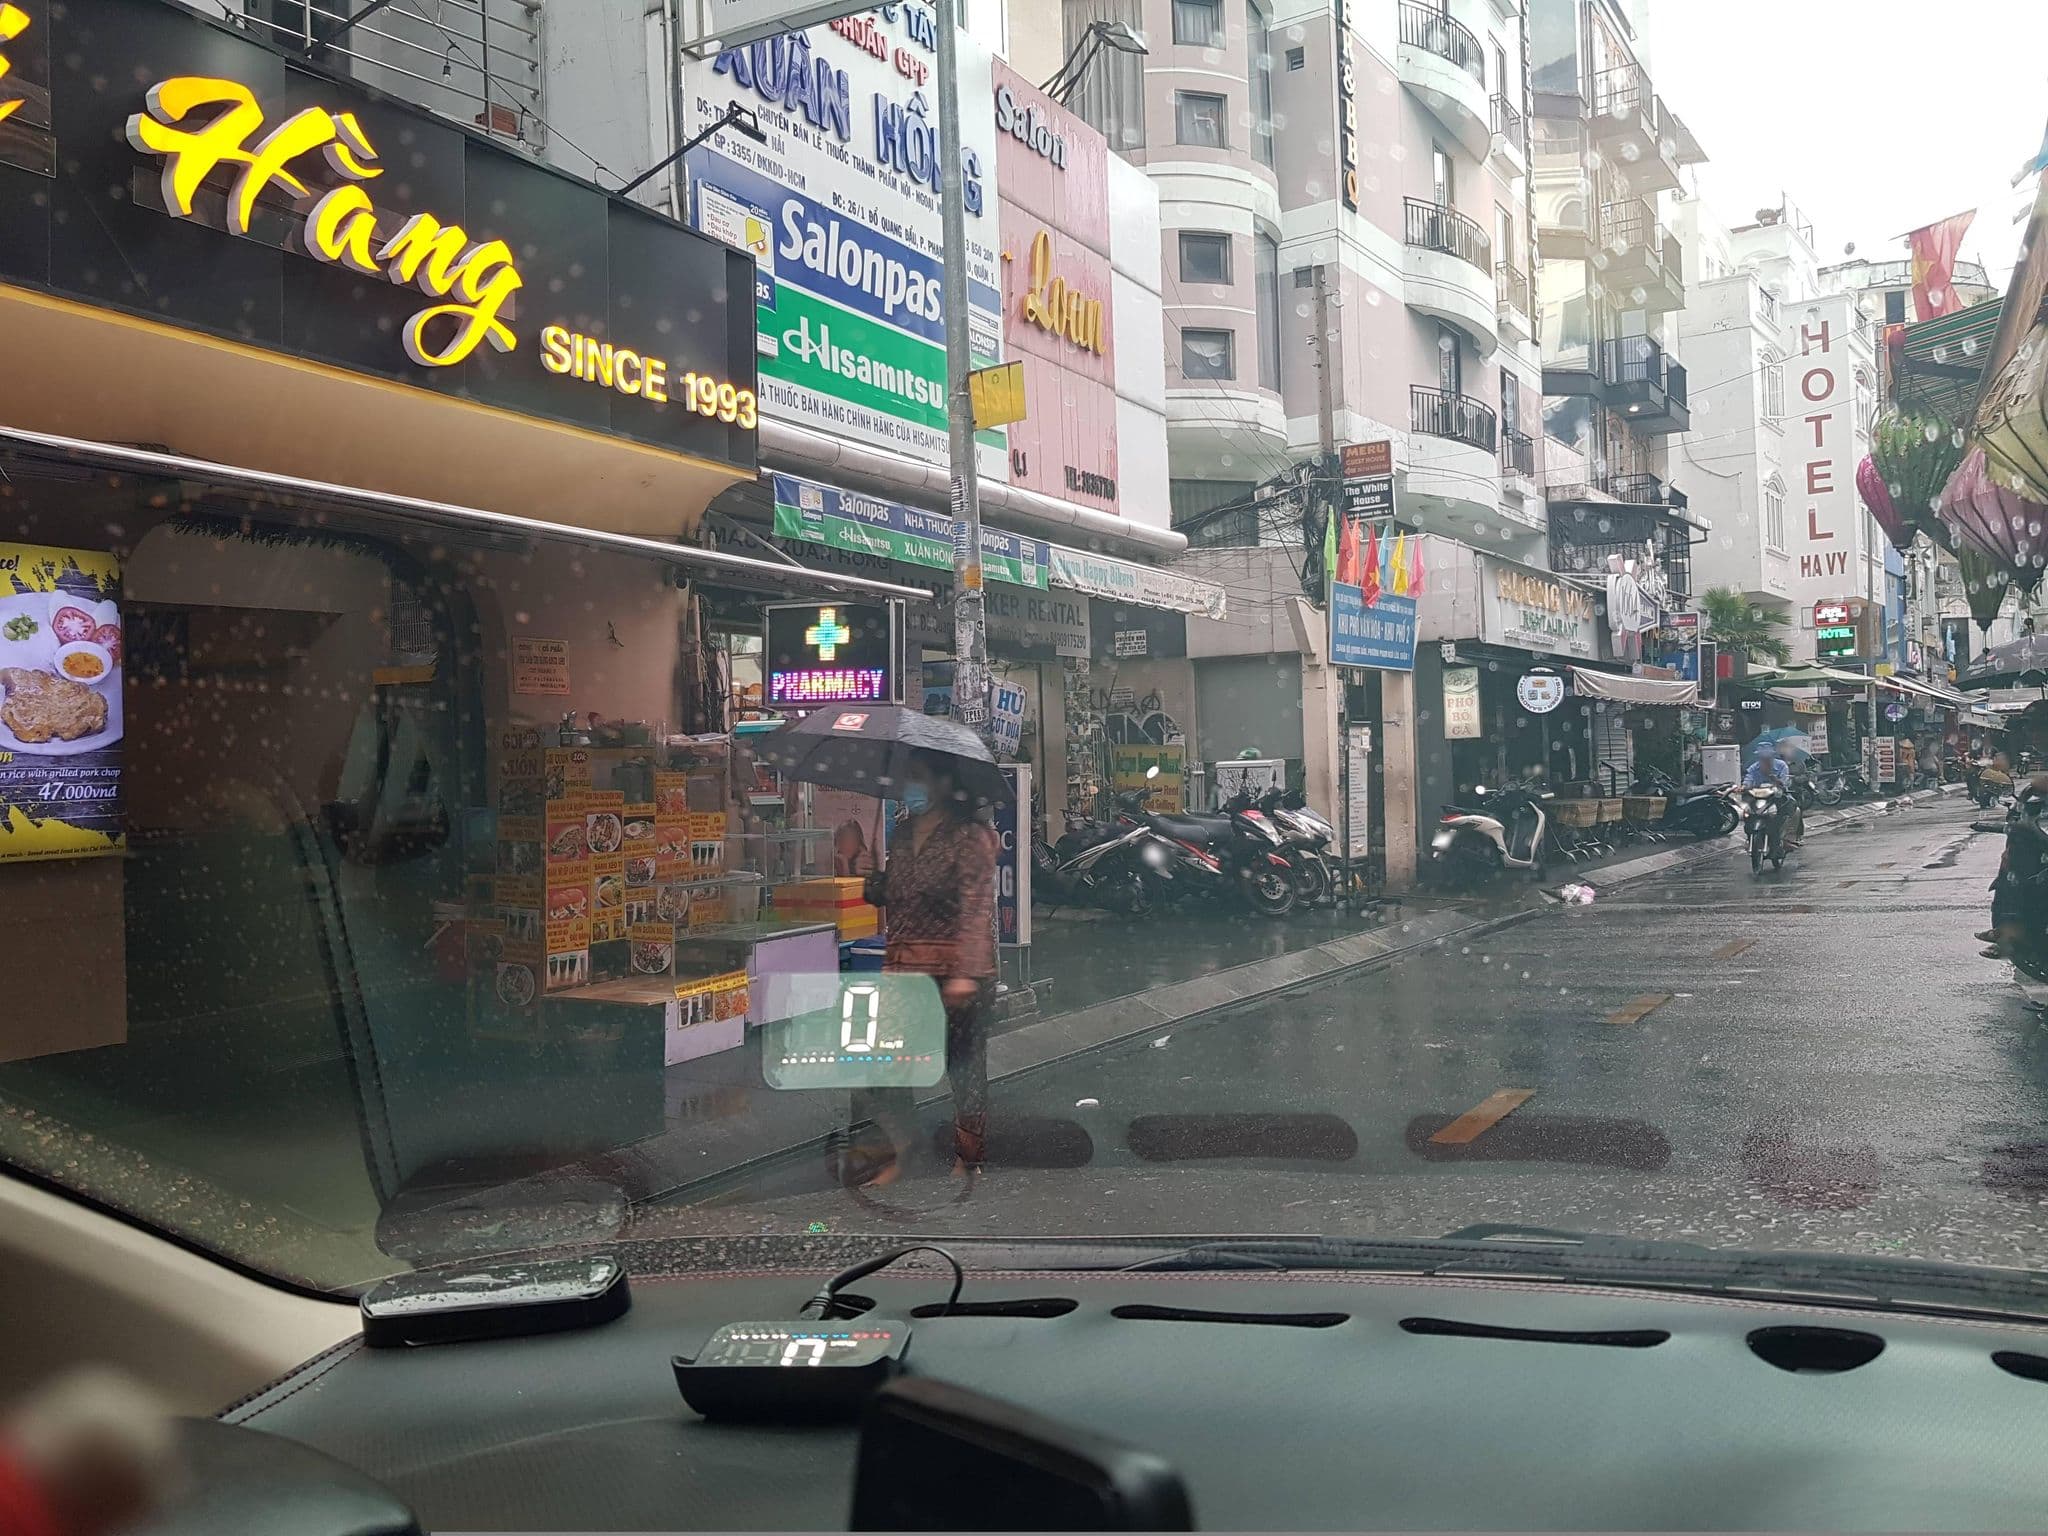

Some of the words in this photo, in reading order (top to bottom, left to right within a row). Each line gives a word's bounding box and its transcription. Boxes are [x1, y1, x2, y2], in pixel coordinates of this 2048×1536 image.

[894, 46, 929, 87] GPP
[757, 103, 791, 134] CHUYÊN
[792, 119, 809, 145] BÁN
[825, 139, 850, 165] THUỐC
[852, 154, 876, 181] THÀNH
[994, 84, 1068, 172] Salon
[881, 217, 903, 240] QUANG
[779, 199, 942, 323] Salonpas
[540, 326, 668, 404] SINCE
[680, 371, 758, 431] 1993
[783, 316, 943, 410] Hisamitsu
[768, 383, 800, 410] THUỐC
[801, 394, 820, 416] BÁN
[821, 399, 845, 425] HÀNG
[846, 407, 872, 430] CHÍNH
[873, 415, 895, 439] HÃNG
[895, 421, 912, 444] CỦA
[1800, 320, 1836, 542] HOTEL
[1346, 443, 1386, 458] MERU
[1344, 487, 1360, 497] The
[1361, 483, 1389, 495] White
[1353, 495, 1381, 506] House
[839, 494, 890, 522] Salonpas
[839, 526, 892, 552] Hisamitsu
[1028, 598, 1084, 627] RENTAL
[771, 669, 883, 701] PHARMACY
[9, 768, 26, 779] rice
[28, 767, 49, 778] with
[49, 767, 78, 780] grilled
[79, 767, 100, 780] pork
[101, 767, 121, 780] chop
[1163, 783, 1179, 796] Rent
[841, 981, 880, 1053] 0
